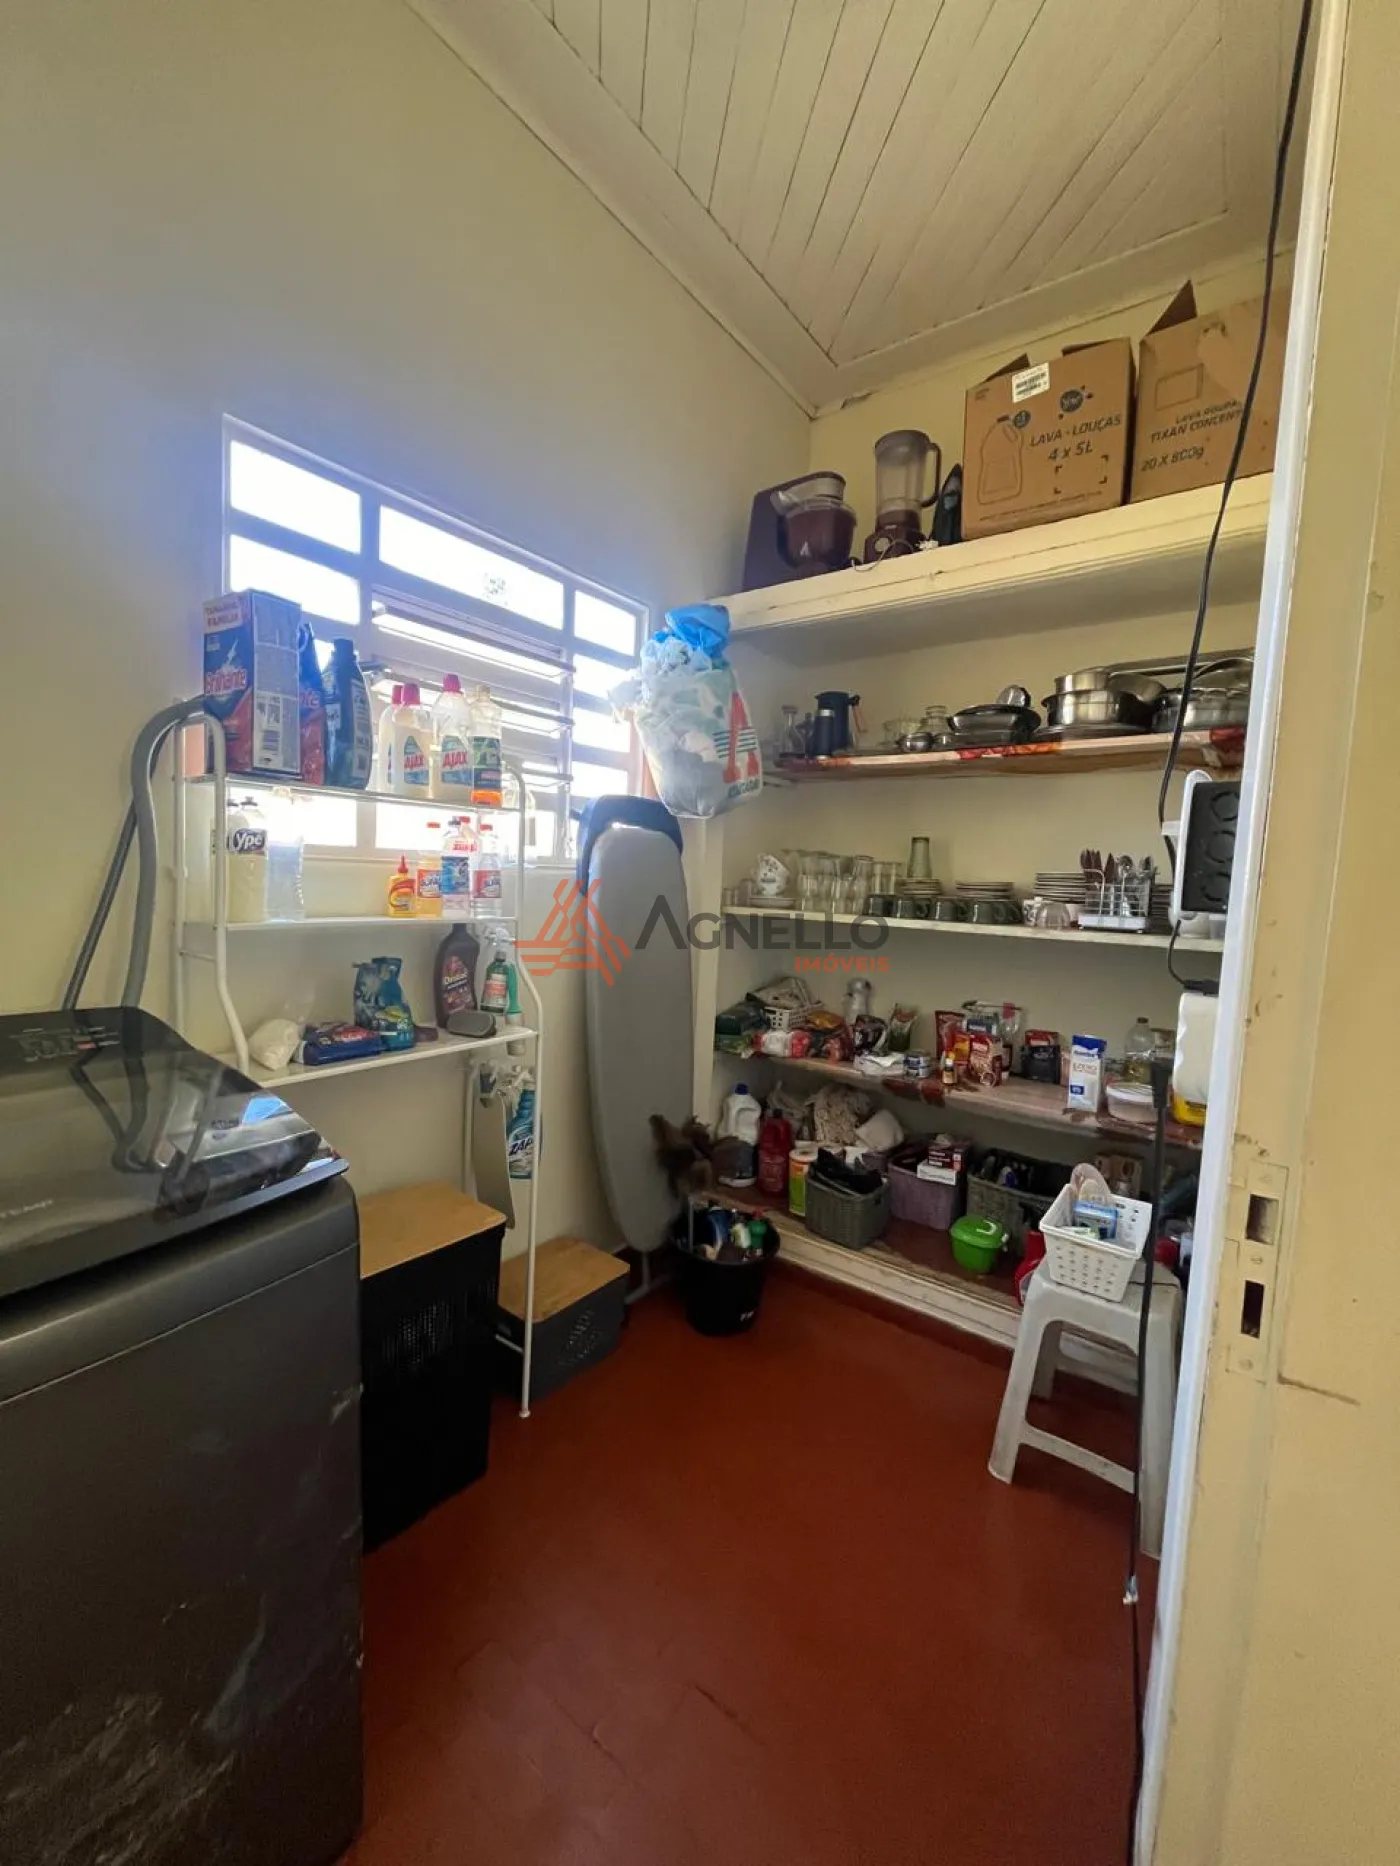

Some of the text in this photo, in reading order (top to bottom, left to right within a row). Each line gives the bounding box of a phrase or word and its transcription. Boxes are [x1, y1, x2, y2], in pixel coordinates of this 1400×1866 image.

[1029, 429, 1062, 447] LAVA
[1072, 414, 1122, 437] LOUÇAS
[1048, 448, 1058, 460] 4
[1075, 440, 1093, 456] 5L
[1141, 457, 1157, 472] 20
[442, 750, 469, 770] AJAX
